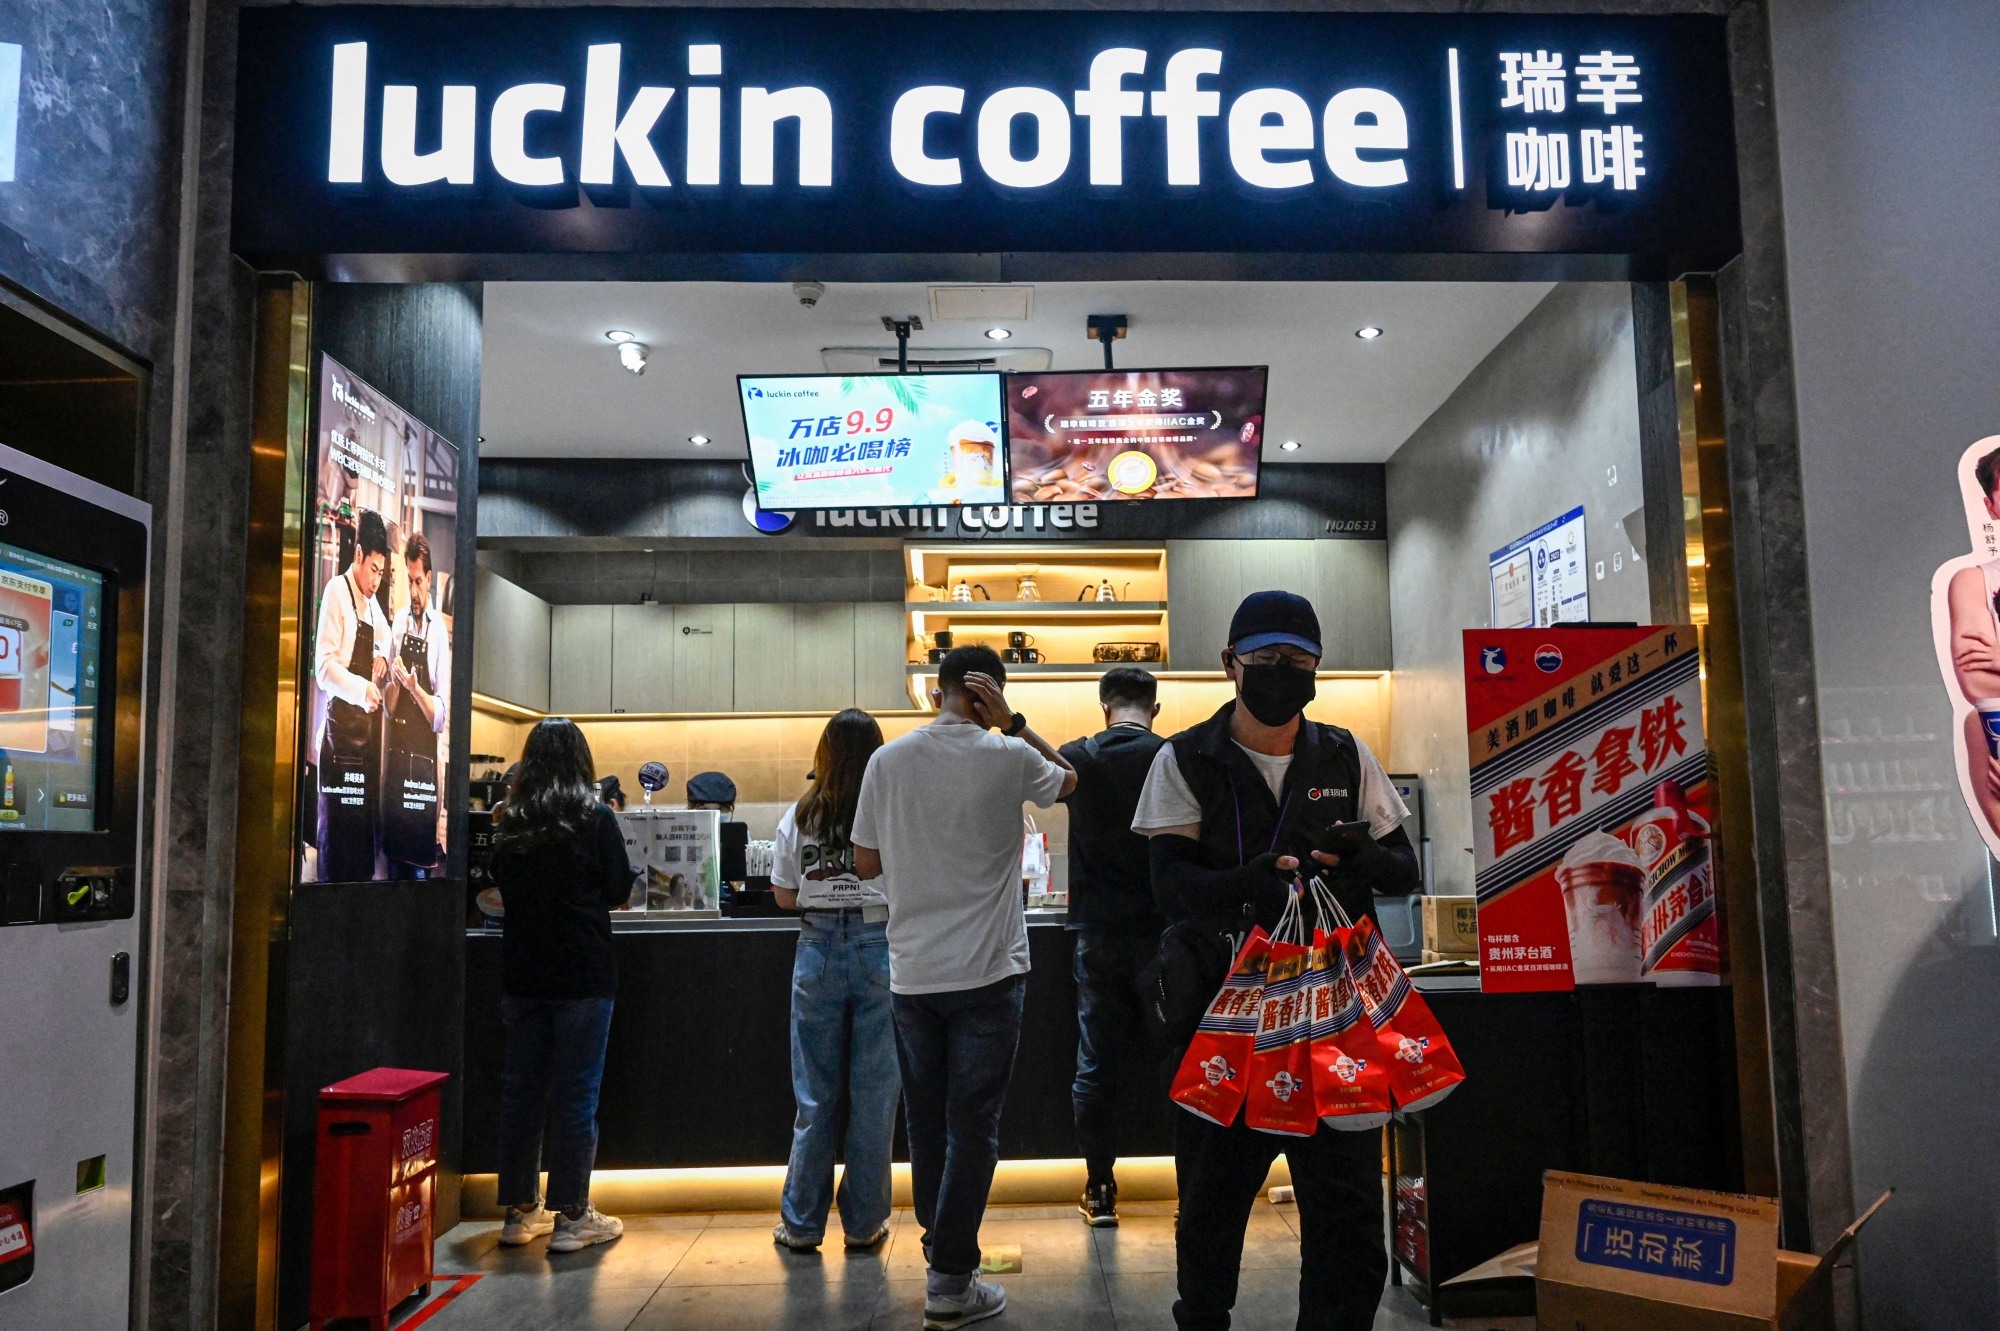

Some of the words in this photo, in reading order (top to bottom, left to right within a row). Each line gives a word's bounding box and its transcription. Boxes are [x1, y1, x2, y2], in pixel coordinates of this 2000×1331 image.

[1500, 50, 1643, 114] 瑞幸
[328, 42, 832, 186] luckin
[890, 48, 1408, 189] coffee
[1506, 126, 1646, 192] 咖啡
[766, 390, 792, 398] luckin
[793, 390, 819, 398] coffee
[1087, 389, 1183, 408] 五年金奖
[788, 407, 894, 439] 万店9.9
[776, 438, 912, 468] 冰咖必喝榜
[815, 505, 948, 527] luckin
[962, 505, 1098, 528] coffee
[1326, 520, 1377, 531] NO.0633
[1487, 687, 1576, 752] 美酒加咖啡
[1590, 631, 1678, 696] 就爱这一杯
[1488, 695, 1688, 859] 酱香拿铁
[832, 884, 860, 892] PRPN!
[1487, 935, 1519, 943] 每杯都含
[1211, 988, 1264, 1016] 酱香拿
[1641, 1189, 1670, 1201] Shanghai
[1708, 1201, 1735, 1212] Printing
[1604, 1227, 1703, 1271] 活动款
